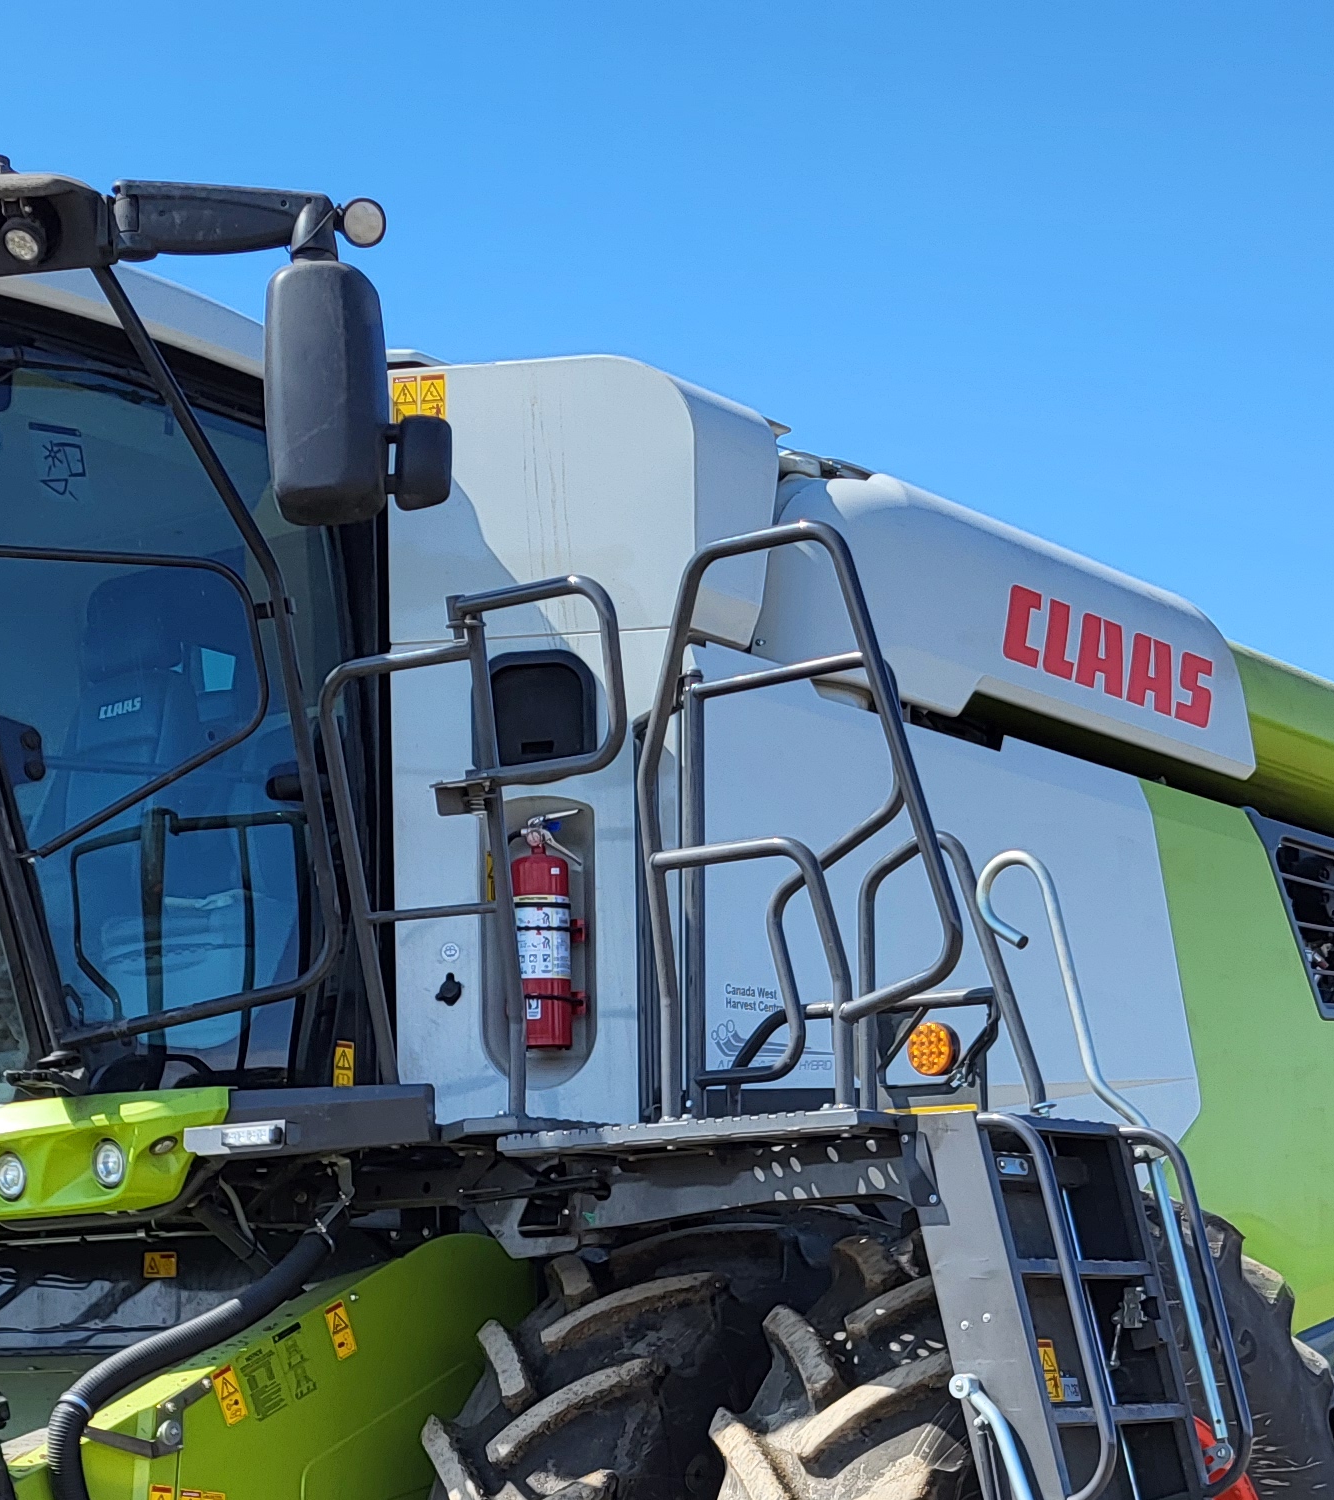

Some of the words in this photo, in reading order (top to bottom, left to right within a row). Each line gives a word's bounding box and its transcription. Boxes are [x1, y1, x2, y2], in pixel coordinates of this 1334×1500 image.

[1003, 584, 1213, 729] CLAAS
[98, 697, 142, 720] CLAAS
[725, 984, 756, 998] Canada
[757, 986, 778, 1000] West
[725, 998, 757, 1012] Harvest
